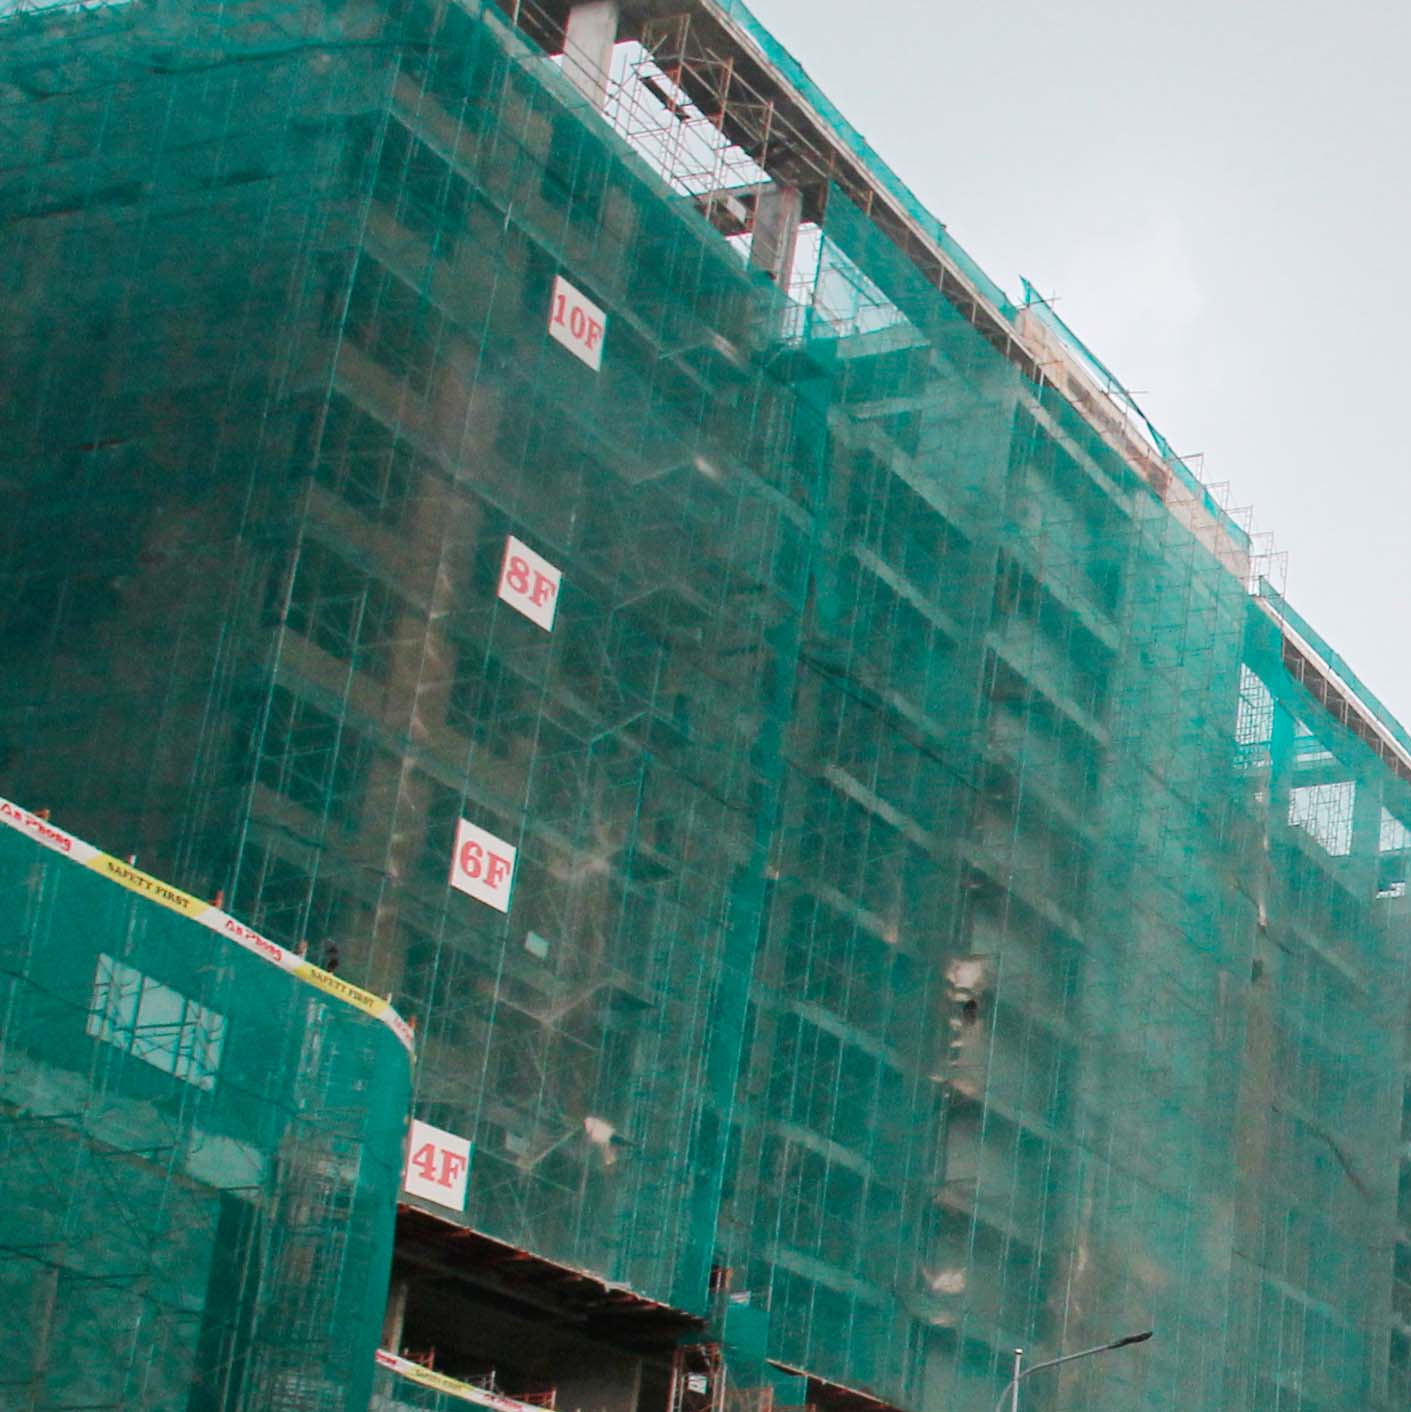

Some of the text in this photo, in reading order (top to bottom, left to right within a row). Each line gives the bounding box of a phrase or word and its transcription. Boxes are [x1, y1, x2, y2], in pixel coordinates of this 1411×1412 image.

[554, 294, 603, 351] 10F
[506, 555, 557, 608] 8F
[107, 862, 192, 909] SAFETY FIRST
[460, 840, 512, 890] 6F
[412, 1142, 467, 1189] 4F
